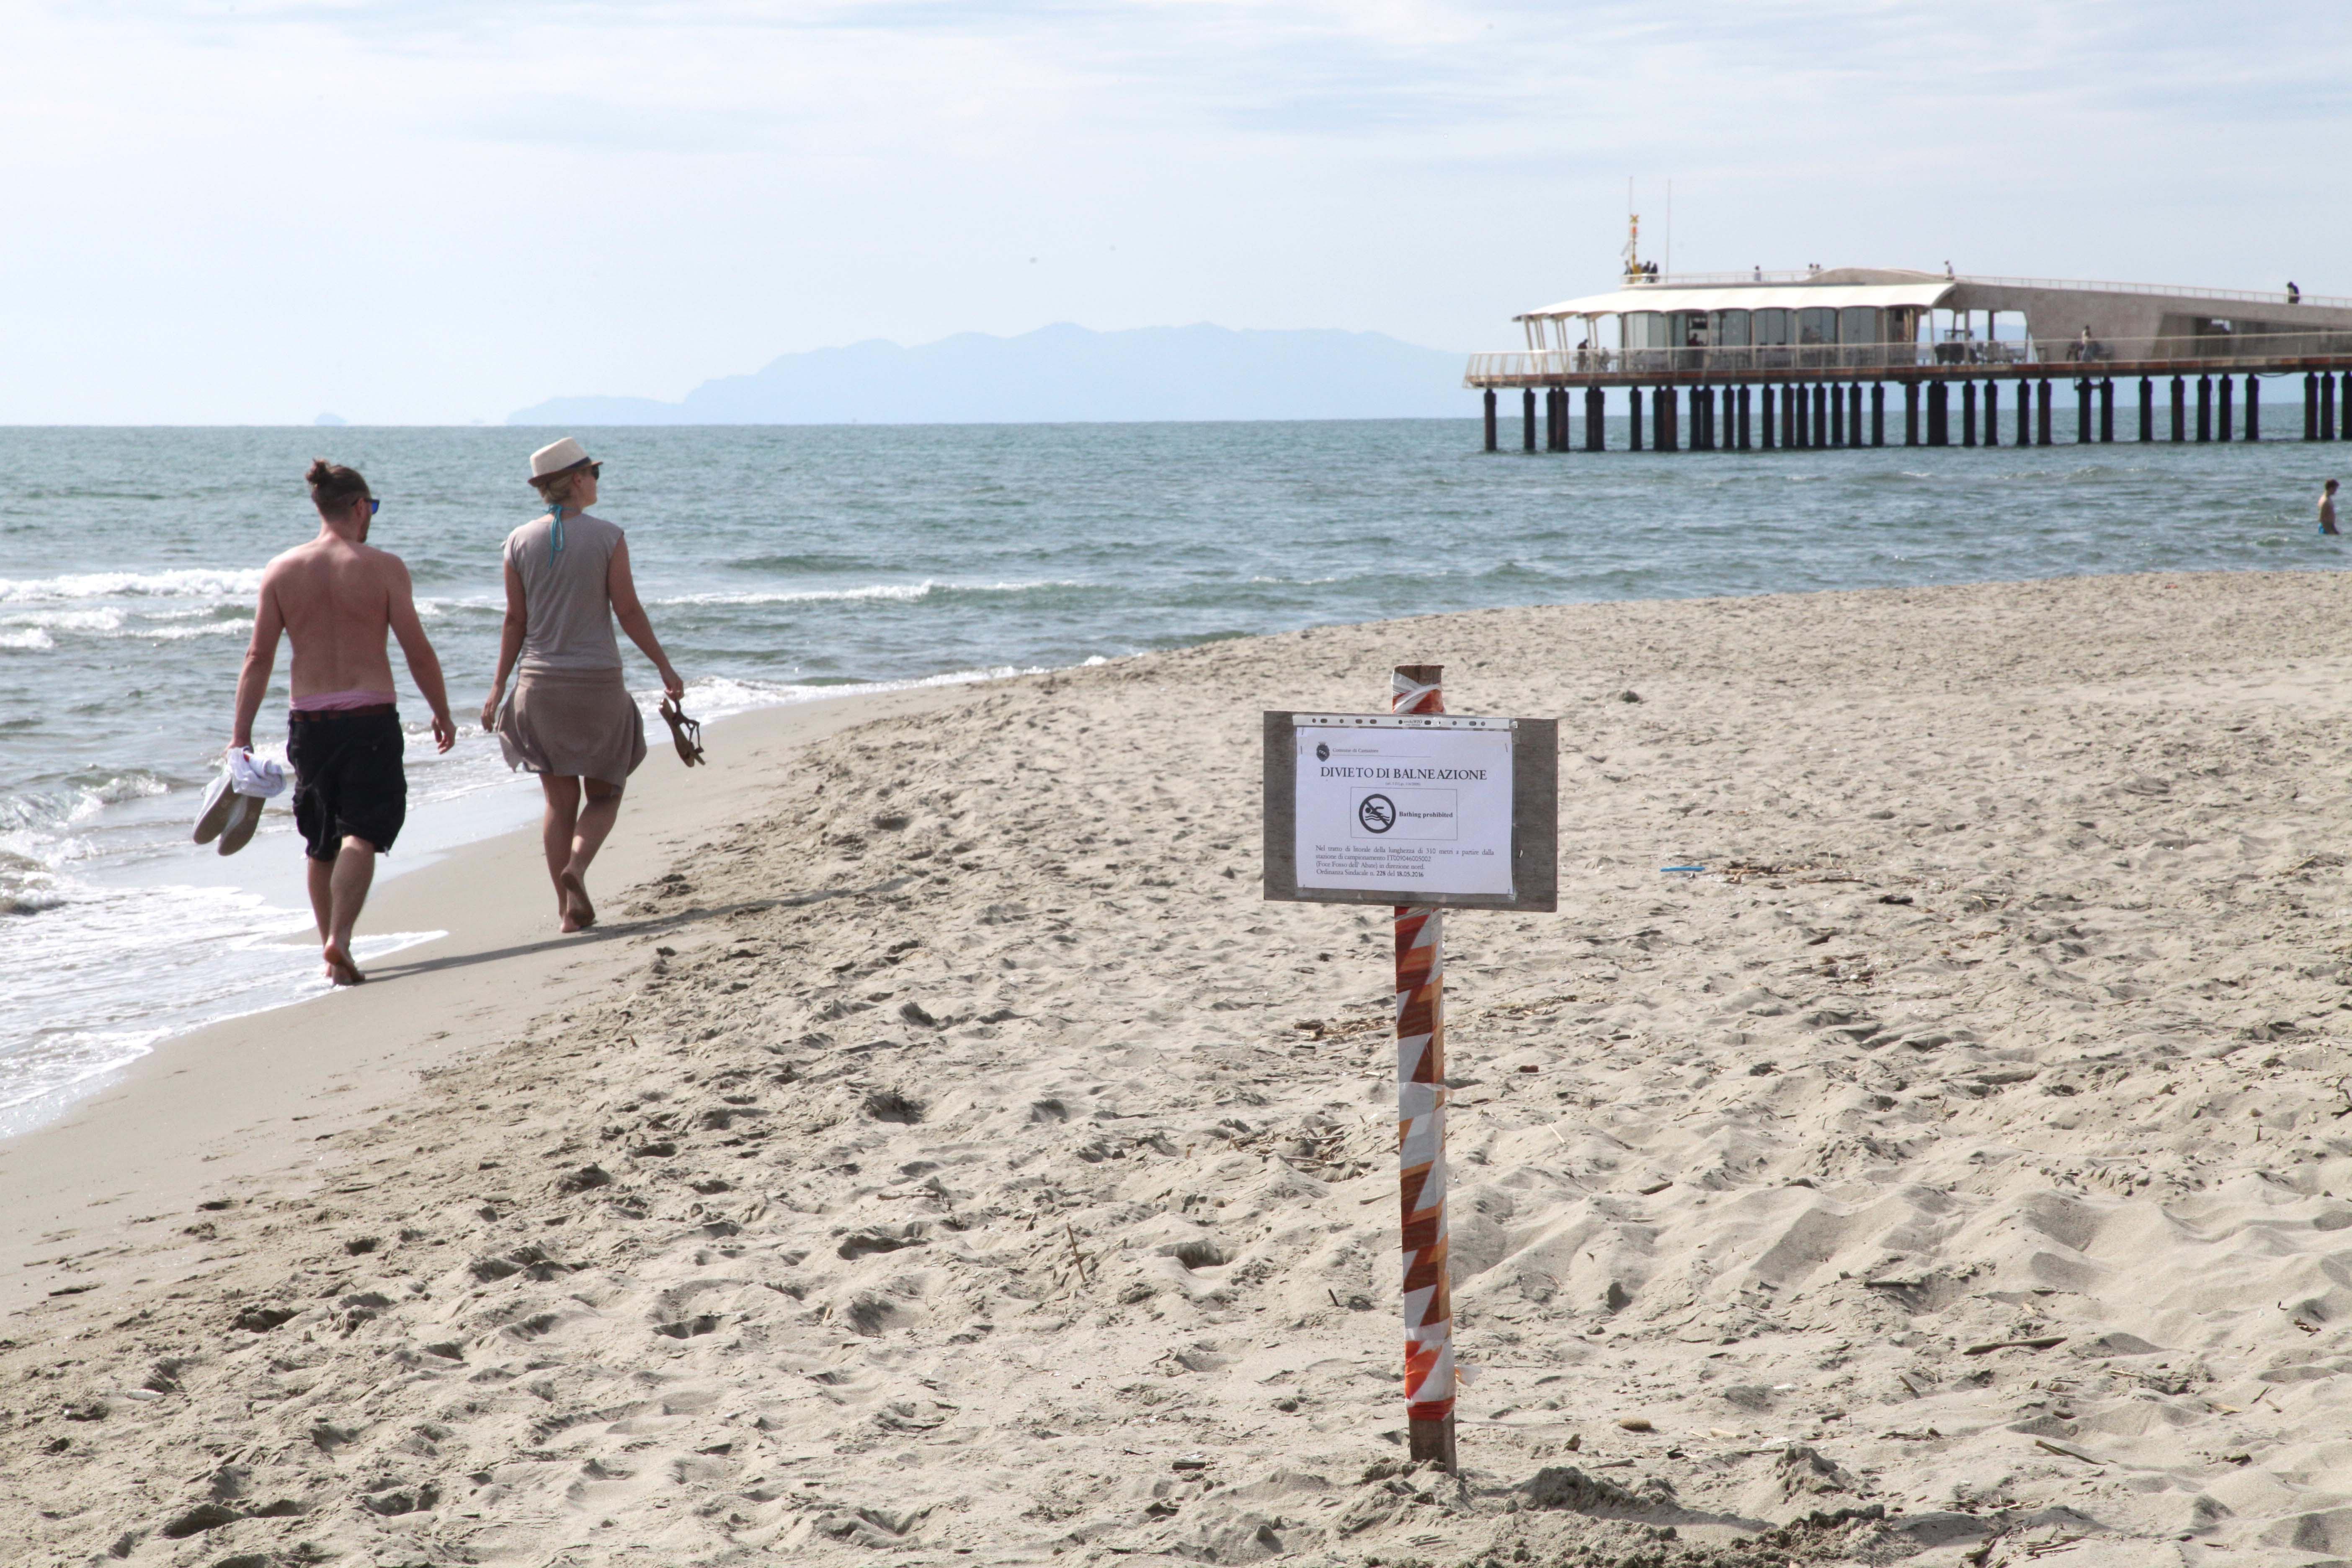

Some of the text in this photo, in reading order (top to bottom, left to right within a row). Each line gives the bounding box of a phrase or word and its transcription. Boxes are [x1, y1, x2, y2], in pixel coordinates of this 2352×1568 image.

[1320, 767, 1487, 780] DIVIETO DI BALNEAZIONE
